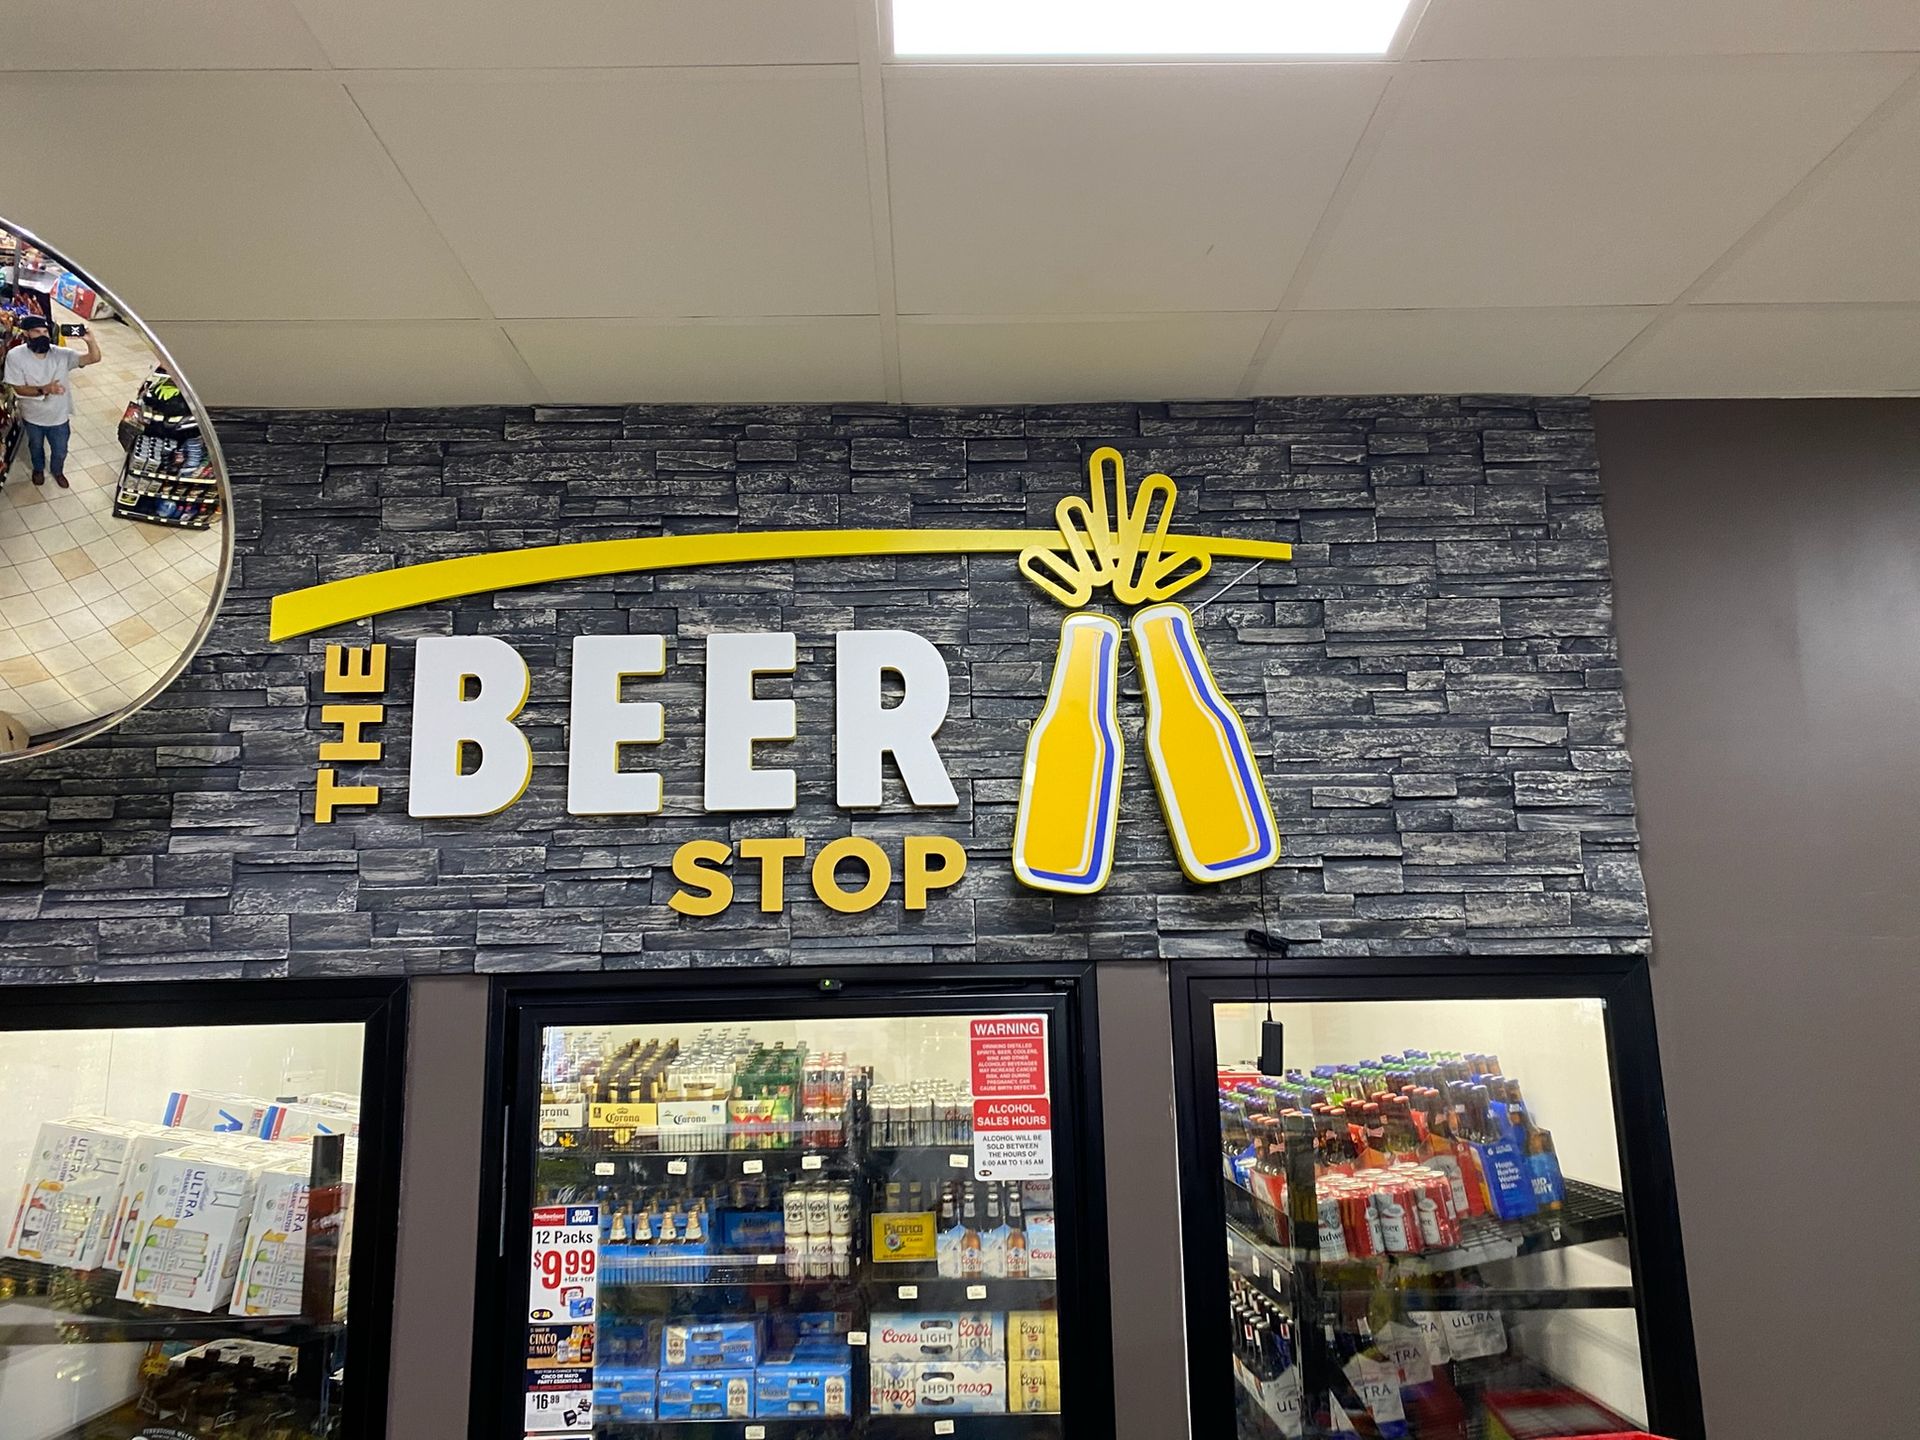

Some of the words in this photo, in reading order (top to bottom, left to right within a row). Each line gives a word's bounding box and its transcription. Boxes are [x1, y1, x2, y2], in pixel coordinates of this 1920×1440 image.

[408, 630, 959, 818] BEER
[314, 643, 387, 823] THE
[668, 835, 968, 916] STOP
[974, 1022, 1040, 1036] WARNING
[540, 1108, 569, 1117] orona
[988, 1104, 1036, 1114] ALCOHOL
[605, 1112, 640, 1124] Corona
[673, 1114, 707, 1125] Corona
[977, 1116, 1010, 1126] SALES
[1011, 1115, 1047, 1126] HOURS
[67, 1137, 89, 1182] ULTRA
[183, 1170, 206, 1219] ULTRA
[293, 1184, 311, 1233] ULTRA
[572, 1215, 593, 1223] LIGHT
[536, 1231, 550, 1245] 12
[555, 1230, 593, 1244] Packs
[1452, 1311, 1494, 1328] ULTRA
[529, 1333, 557, 1345] CINCO
[882, 1328, 918, 1344] Coors
[919, 1332, 953, 1343] LIGHT
[536, 1345, 556, 1355] MAYO
[921, 1382, 956, 1394] LIGHT
[957, 1383, 992, 1396] Coors
